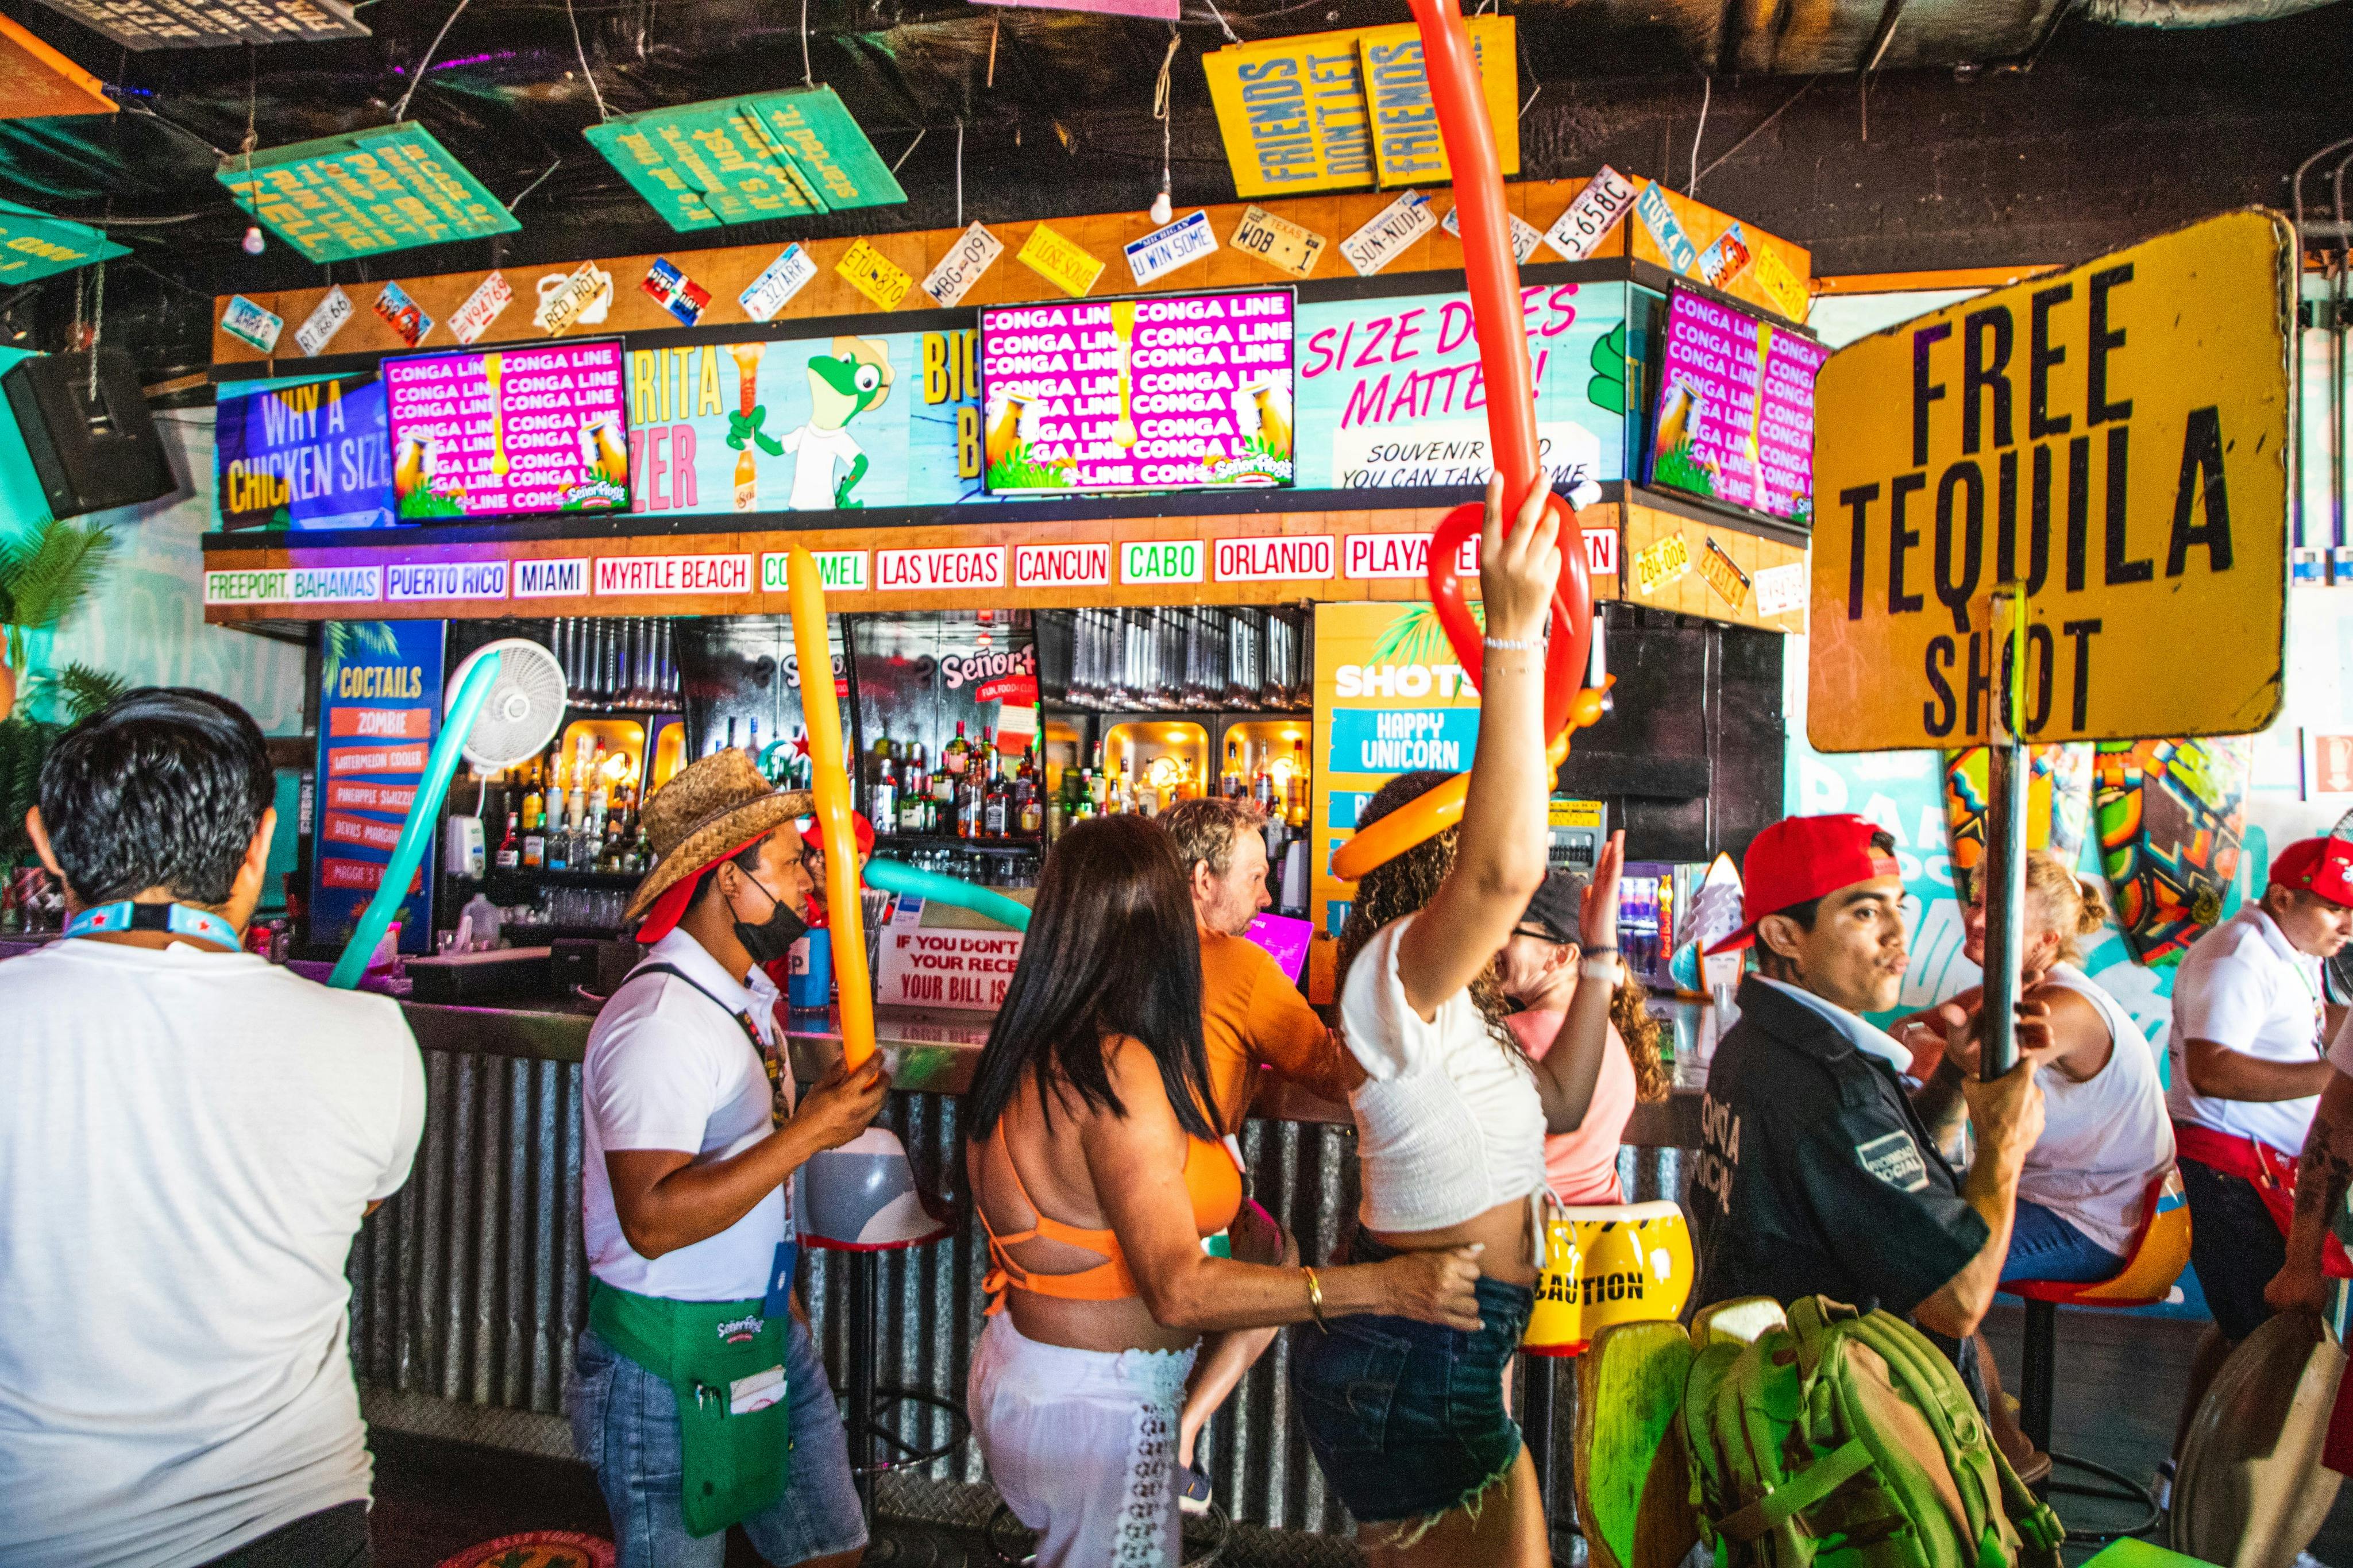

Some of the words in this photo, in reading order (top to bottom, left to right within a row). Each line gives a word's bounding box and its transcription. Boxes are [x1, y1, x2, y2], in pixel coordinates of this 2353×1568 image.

[1305, 49, 1361, 99] LET
[1236, 56, 1318, 183] FRIENDS
[1368, 37, 1441, 174] FRIENDS
[686, 124, 764, 175] just
[1314, 100, 1374, 175] DON'T
[645, 167, 688, 191] not
[782, 128, 861, 199] started
[342, 152, 406, 194] PAY
[391, 195, 457, 240] BILL
[415, 159, 473, 201] CASE
[733, 176, 786, 210] It's
[261, 168, 327, 211] RUN
[314, 210, 380, 250] LIKE
[1364, 210, 1395, 237] Virginia
[1141, 218, 1190, 249] MICHIGAN
[1268, 217, 1303, 240] TEXAS
[1349, 202, 1428, 269] SUN-NUDE
[1641, 190, 1670, 235] TUX
[1665, 229, 1680, 252] 4
[1675, 245, 1692, 273] U
[1023, 232, 1043, 254] U
[1033, 239, 1068, 271] LOSE
[1059, 256, 1096, 290] SOME
[1131, 256, 1147, 278] U
[1145, 242, 1174, 271] WIN
[1171, 223, 1212, 259] SOME
[1236, 221, 1276, 255] WOB
[1296, 249, 1314, 272] 1
[866, 249, 900, 279] ALASKA
[927, 264, 965, 304] MBG
[961, 226, 997, 266] 091
[646, 268, 674, 299] REP
[759, 255, 809, 306] 327ARR
[327, 292, 349, 320] 66
[462, 276, 512, 328] V94769
[543, 295, 573, 329] RED
[570, 267, 600, 302] HOT
[985, 308, 1067, 331] CONGA
[1133, 299, 1225, 323] CONGA
[1229, 296, 1285, 318] LINE
[988, 333, 1076, 356] CONGA
[1139, 324, 1233, 348] CONGA
[1239, 321, 1292, 343] LINE
[1302, 308, 1426, 379] SIZE
[1673, 293, 1731, 332] CONGA
[1769, 333, 1820, 368] CONGA
[1674, 319, 1733, 358] CONGA
[389, 363, 453, 383] CONGA
[500, 353, 568, 373] CONGA
[572, 350, 612, 368] LINE
[985, 353, 1069, 376] CONGA
[1132, 345, 1225, 369] CONGA
[1230, 342, 1286, 364] LINE
[1669, 339, 1727, 376] CONGA
[1912, 263, 2135, 468] FREE
[394, 383, 459, 403] CONGA
[505, 374, 574, 395] CONGA
[577, 370, 619, 389] LINE
[1139, 370, 1233, 393] CONGA
[1341, 348, 1549, 430] MATTE!
[263, 384, 320, 447] WHY
[328, 380, 346, 434] A
[391, 400, 456, 420] CONGA
[502, 392, 571, 412] CONGA
[575, 388, 615, 407] LINE
[1132, 391, 1226, 414] CONGA
[507, 412, 576, 432] CONGA
[1140, 416, 1234, 438] CONGA
[1760, 419, 1811, 451] CONGA
[505, 430, 573, 450] CONGA
[1074, 441, 1126, 461] LINE
[1133, 437, 1226, 459] CONGA
[1366, 439, 1484, 464] SOUVENIR
[510, 451, 578, 470] CONGA
[1082, 465, 1133, 485] LINE
[1760, 443, 1811, 475] CONGA
[229, 447, 335, 515] CHICKEN
[465, 473, 503, 490] LINE
[507, 469, 576, 487] CONGA
[1343, 469, 1386, 489] YOU
[1390, 468, 1439, 489] CAN
[470, 493, 508, 510] LINE
[1839, 404, 2235, 635] TEQUILA
[884, 555, 921, 584] LAS
[929, 553, 998, 584] VEGAS
[1020, 550, 1106, 581] CANCUN
[1131, 545, 1194, 577] CABO
[1221, 542, 1329, 576] ORLANDO
[1353, 539, 1429, 571] PLAYA
[1637, 539, 1688, 585] 284-008
[294, 570, 376, 598] BAHAMAS
[390, 568, 457, 596] PUERTO
[462, 566, 502, 594] RICO
[522, 565, 581, 592] MIAMI
[602, 561, 676, 589] MYRTLE
[682, 559, 745, 588] BEACH
[1700, 547, 1711, 570] 2
[1707, 555, 1731, 592] FAST
[1735, 585, 1746, 609] U
[340, 665, 423, 698] COCTAILS
[942, 648, 1021, 689] Señor
[357, 712, 407, 734] ZOMBIE
[1377, 712, 1444, 738] HAPPY
[334, 754, 388, 770] WATERMELON
[391, 751, 422, 767] COOLER
[1361, 739, 1460, 769] UNICORN
[337, 786, 378, 805] PINEAPPLE
[1661, 912, 1672, 934] Bull
[897, 934, 911, 949] IF
[916, 936, 957, 952] YOU
[961, 937, 1019, 954] DON'T
[1661, 935, 1672, 960] Red
[910, 954, 963, 970] YOUR
[901, 974, 943, 1001] YOUR
[948, 977, 983, 1003] BILL
